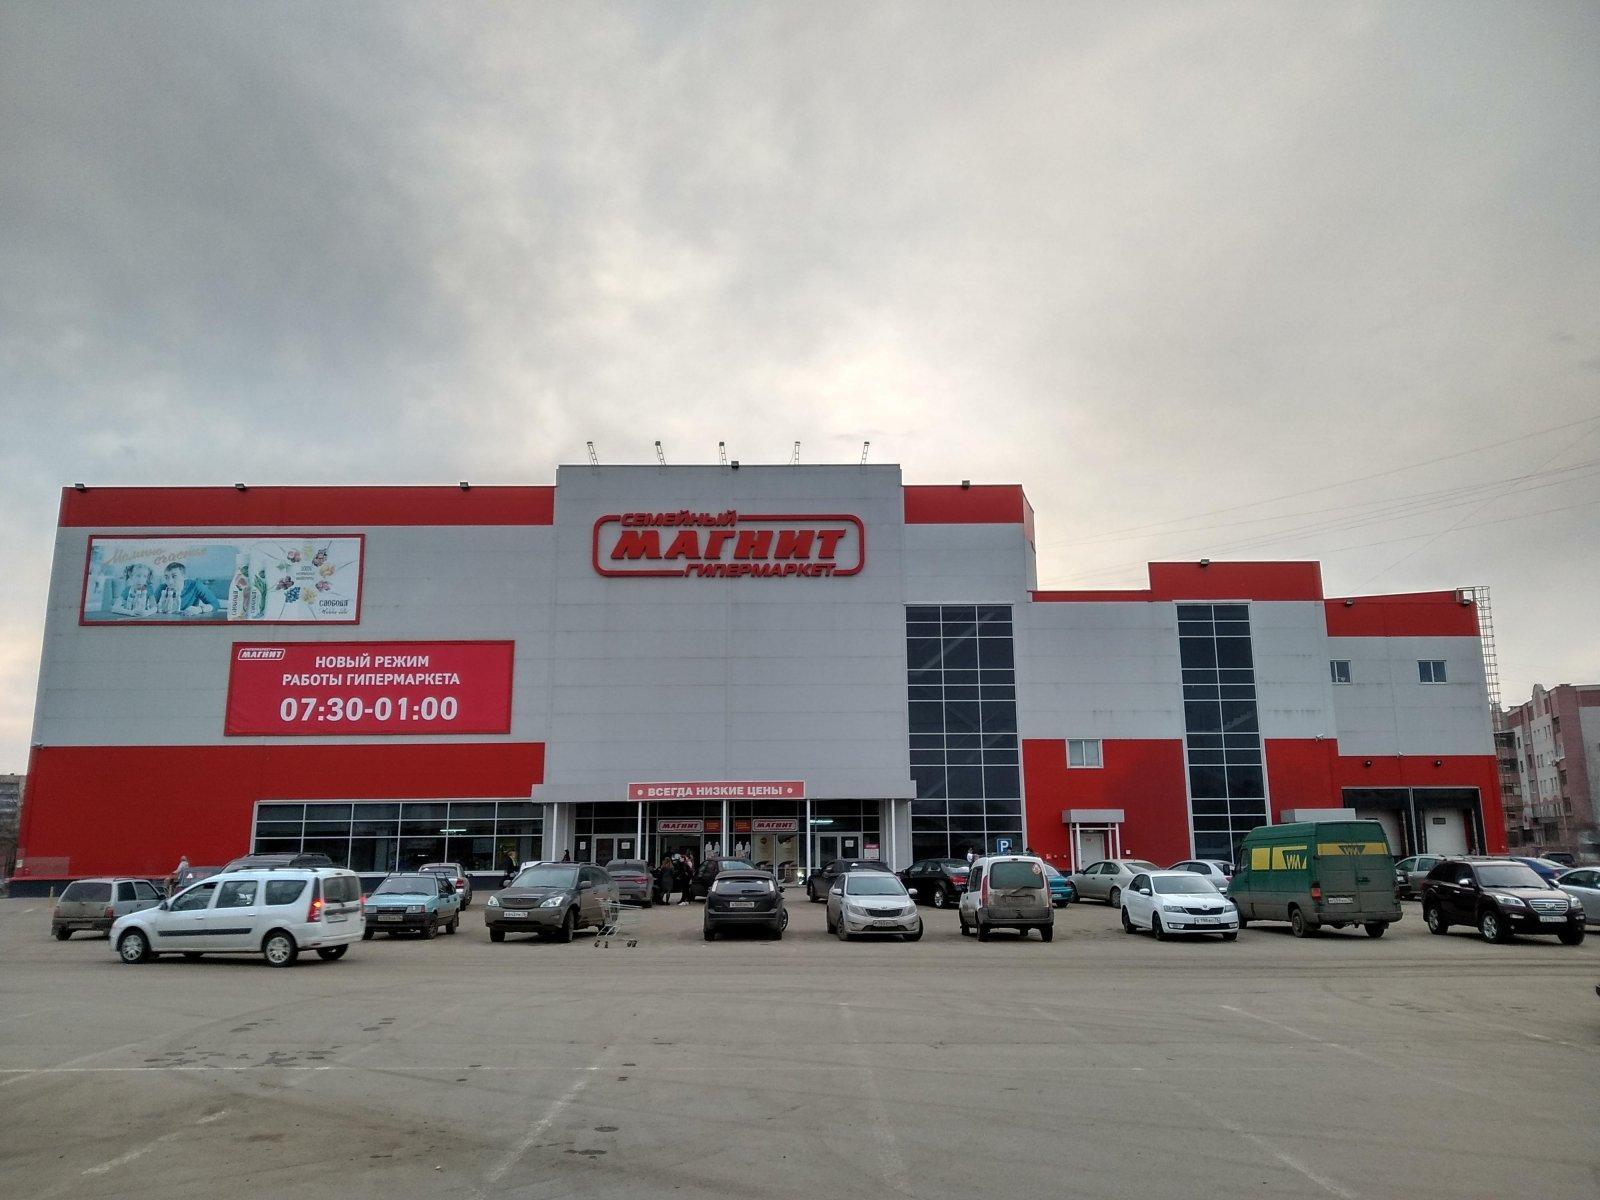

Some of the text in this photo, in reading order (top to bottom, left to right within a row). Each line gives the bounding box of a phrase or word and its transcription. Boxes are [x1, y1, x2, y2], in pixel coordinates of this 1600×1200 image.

[620, 510, 737, 527] СЕМЕЙНЫЙ
[610, 530, 848, 559] МАГНИТ
[683, 563, 837, 578] ГИПЕРМАРКЕТ
[241, 650, 283, 658] МАГНИТ
[315, 653, 430, 668] НОВЫЙ РЕЖИМ
[282, 673, 460, 686] РАБОТЫ ГИПЕРМАРКЕТА
[279, 696, 458, 721] 07:30-01:00
[648, 786, 783, 798] ВСЕГДА НИЗКИЕ ЦЕНЫ
